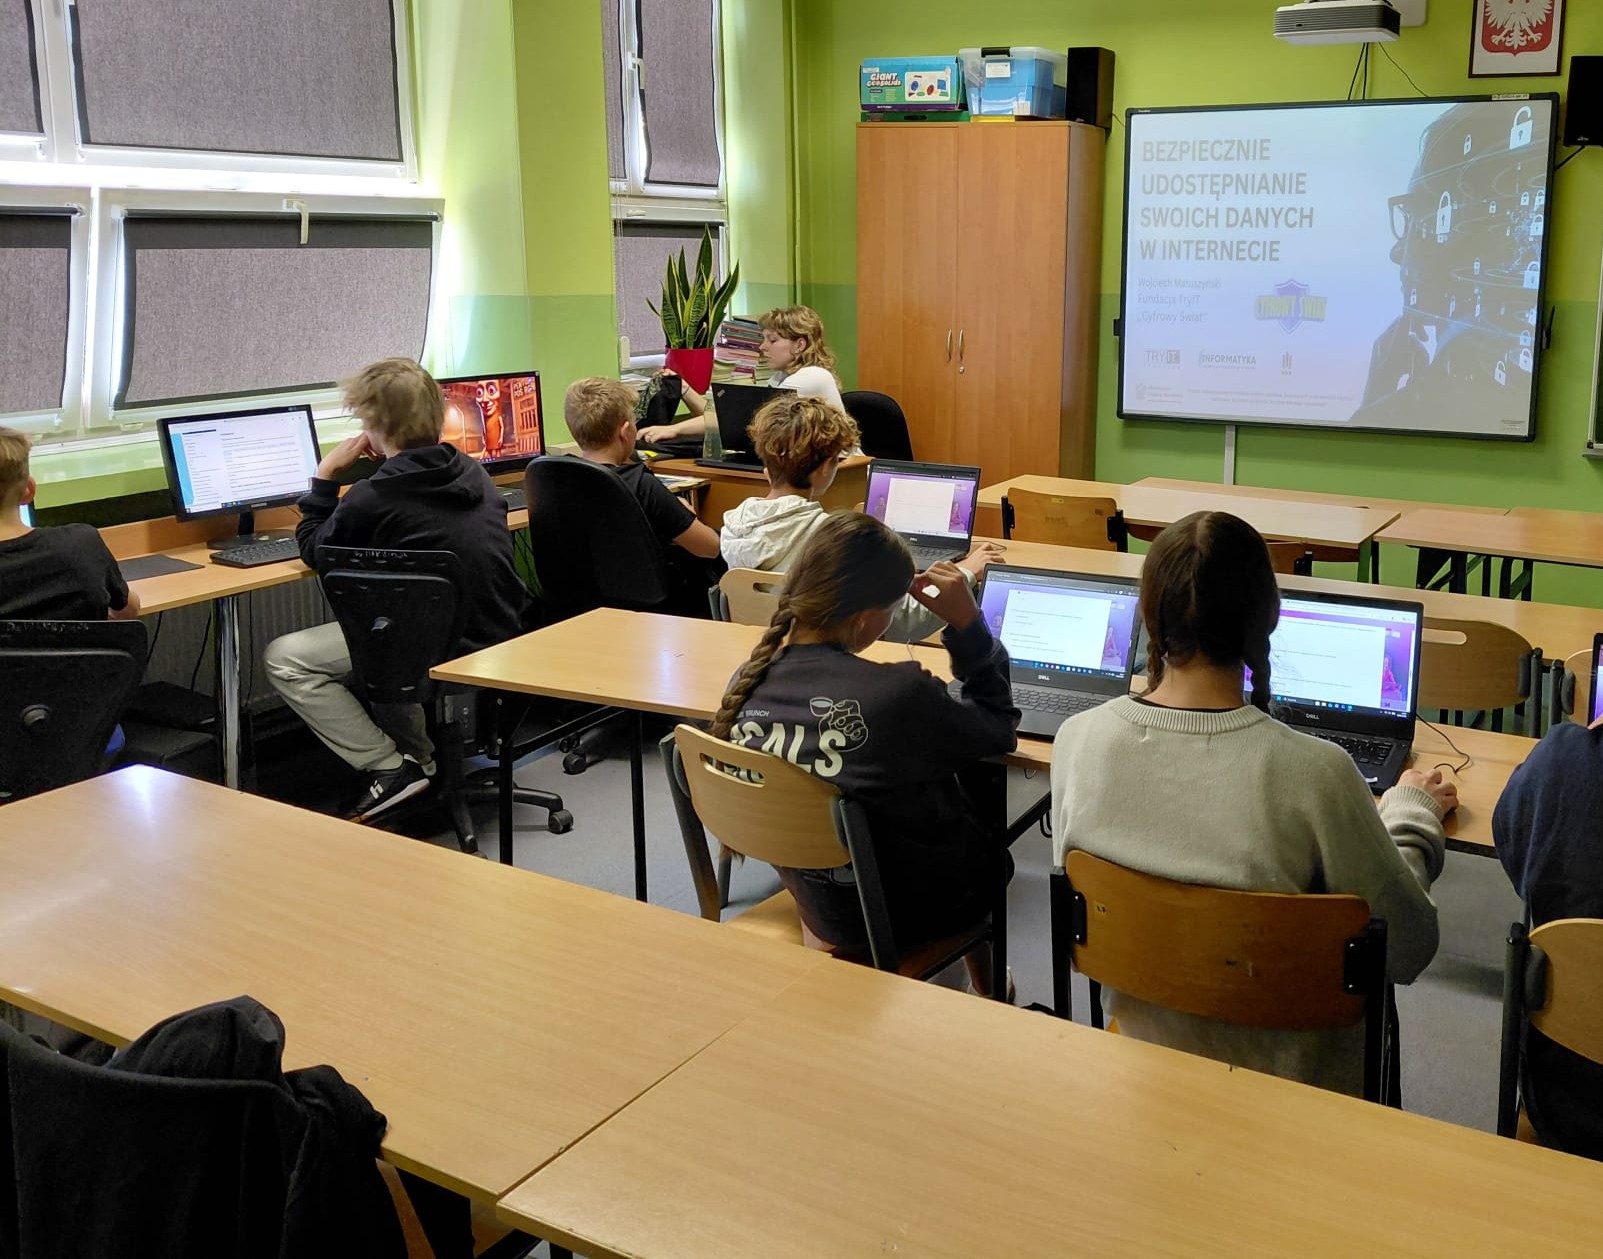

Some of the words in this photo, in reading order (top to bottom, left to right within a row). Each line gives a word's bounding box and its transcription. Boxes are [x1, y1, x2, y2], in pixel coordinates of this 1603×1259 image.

[1142, 138, 1272, 162] BEZPIECZNIE
[1141, 172, 1308, 201] UDOSTĘPNIANIE
[1140, 207, 1219, 228] SWOICH
[1225, 207, 1314, 228] DANYCH
[1139, 239, 1157, 261] W
[1162, 240, 1281, 261] INTERNECIE
